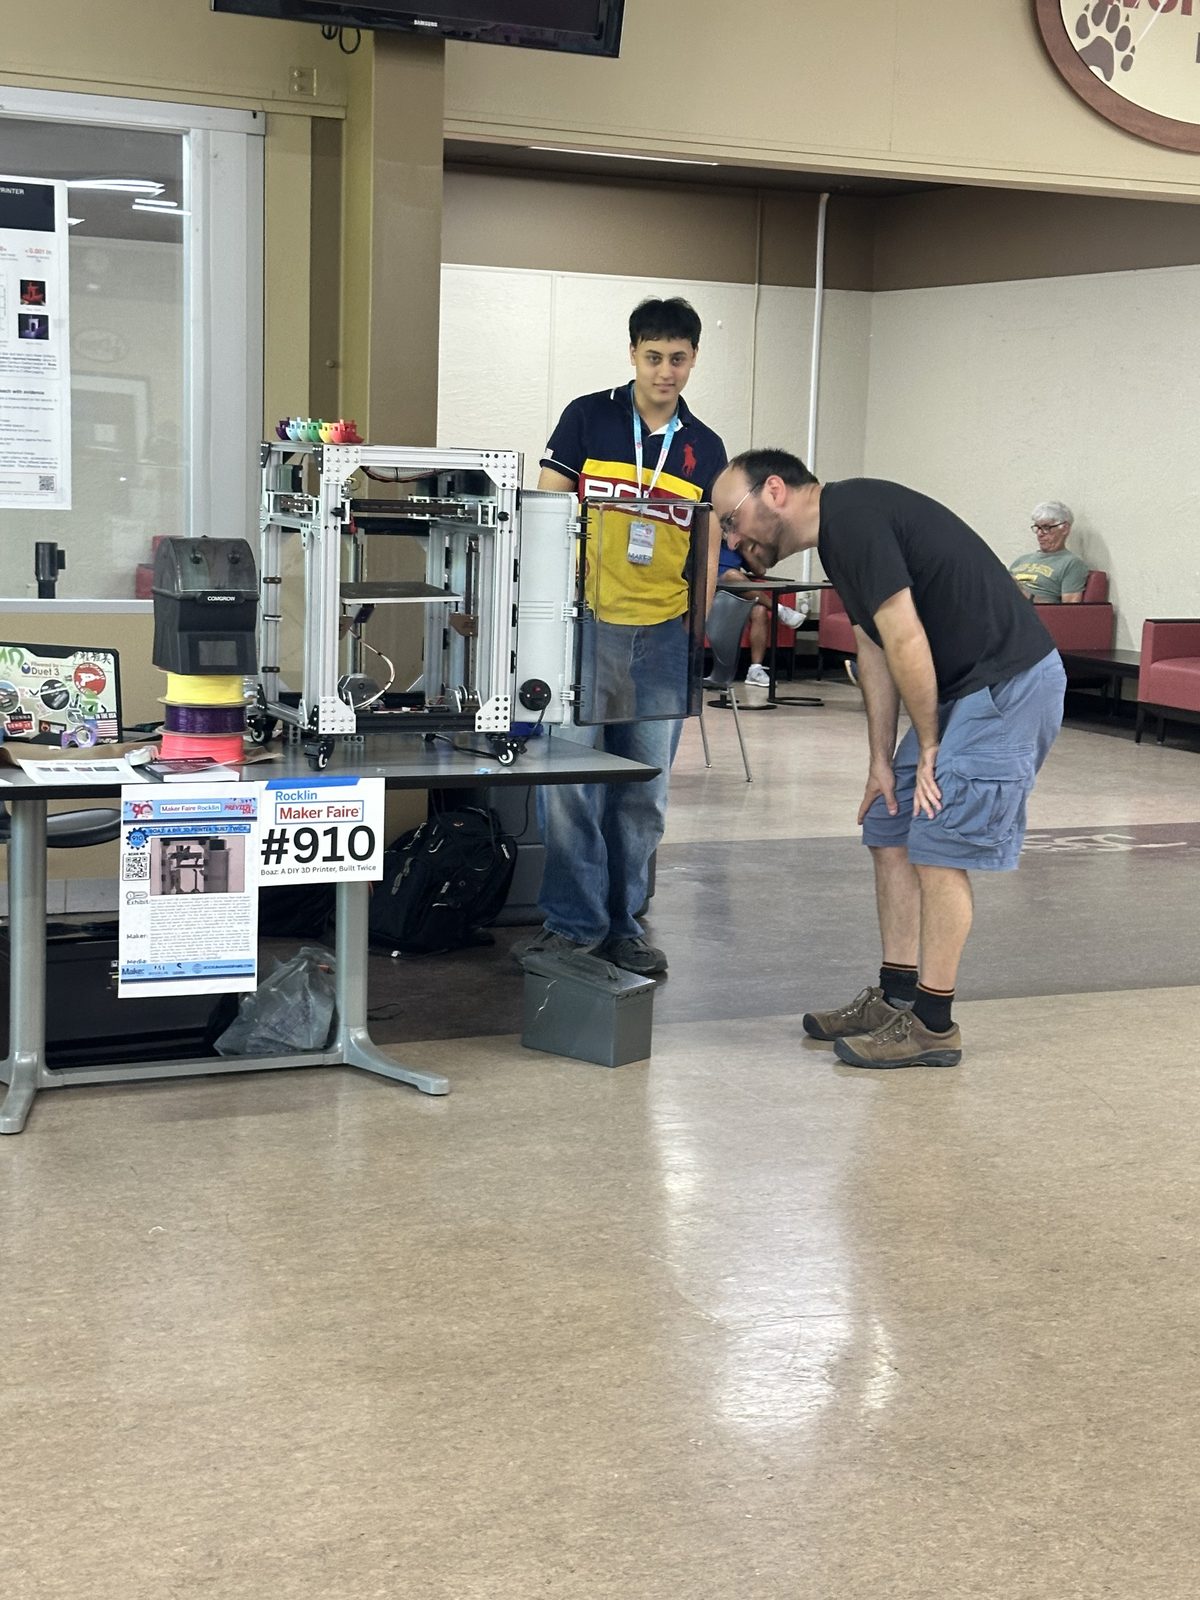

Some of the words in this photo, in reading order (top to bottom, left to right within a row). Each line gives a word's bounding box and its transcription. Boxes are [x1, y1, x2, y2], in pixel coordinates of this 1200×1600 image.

[31, 667, 52, 676] Duet
[54, 667, 60, 676] 3
[275, 790, 318, 801] Rocklin
[280, 807, 323, 820] Maker
[326, 805, 359, 818] Faire
[261, 825, 376, 865] #910
[312, 866, 337, 874] Printer,
